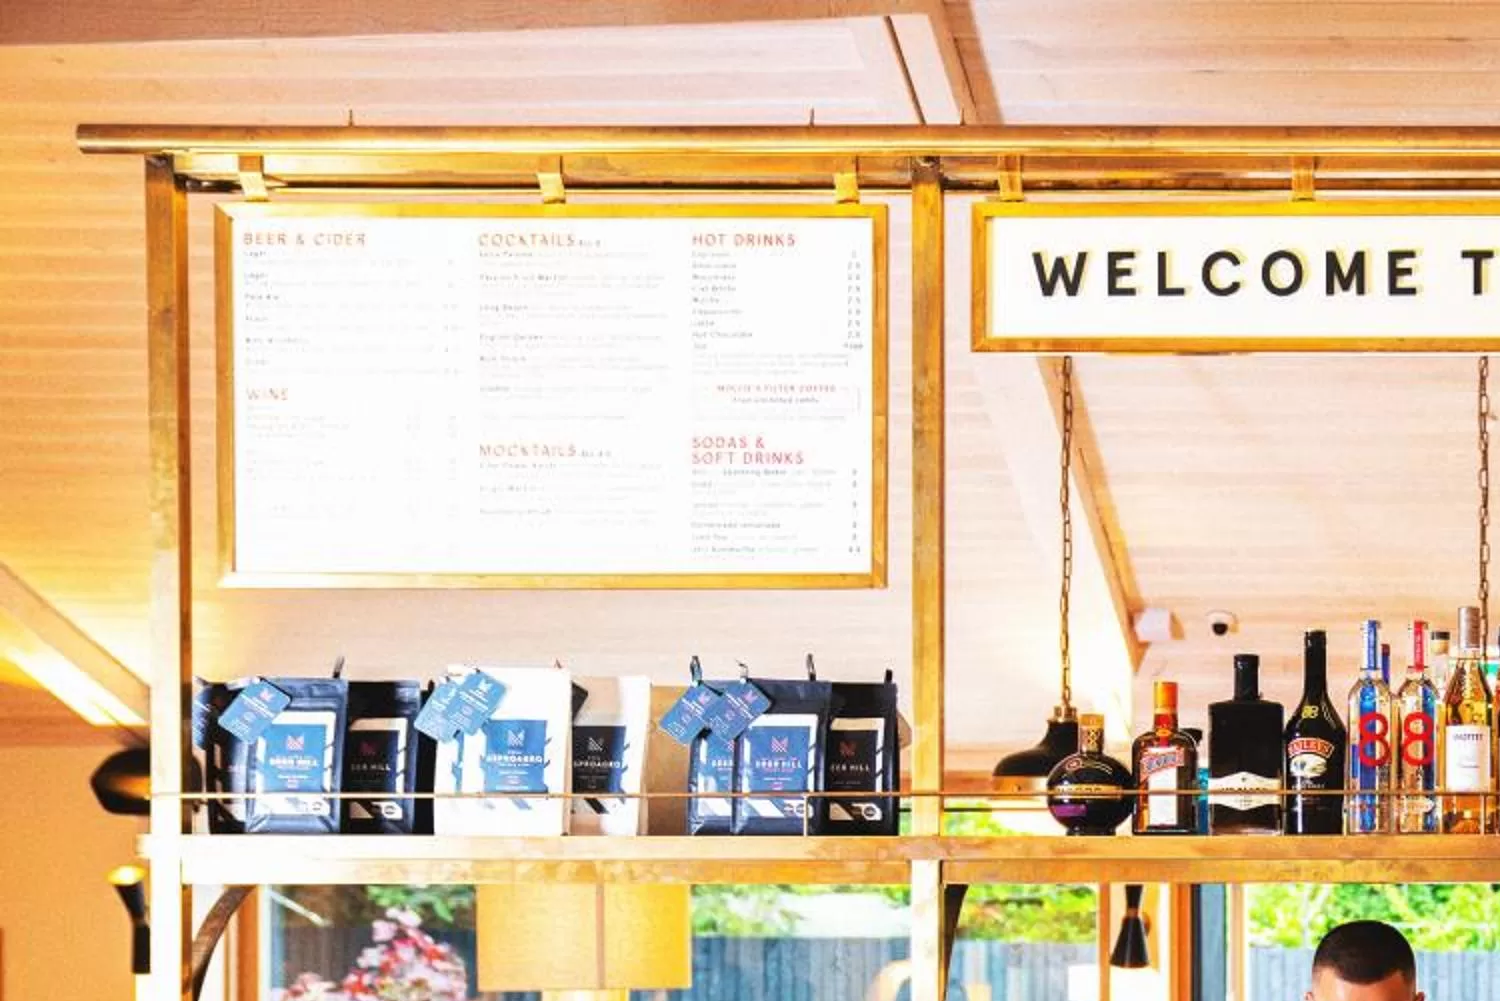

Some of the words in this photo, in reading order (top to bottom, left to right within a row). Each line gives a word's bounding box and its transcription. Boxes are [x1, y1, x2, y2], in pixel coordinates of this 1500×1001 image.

[692, 234, 727, 246] HOT
[734, 234, 796, 246] DRINKS
[1032, 250, 1418, 297] WELCOME
[692, 436, 748, 449] SODAS
[755, 437, 765, 449] &
[692, 452, 734, 465] SOFT
[743, 452, 804, 465] DRINKS
